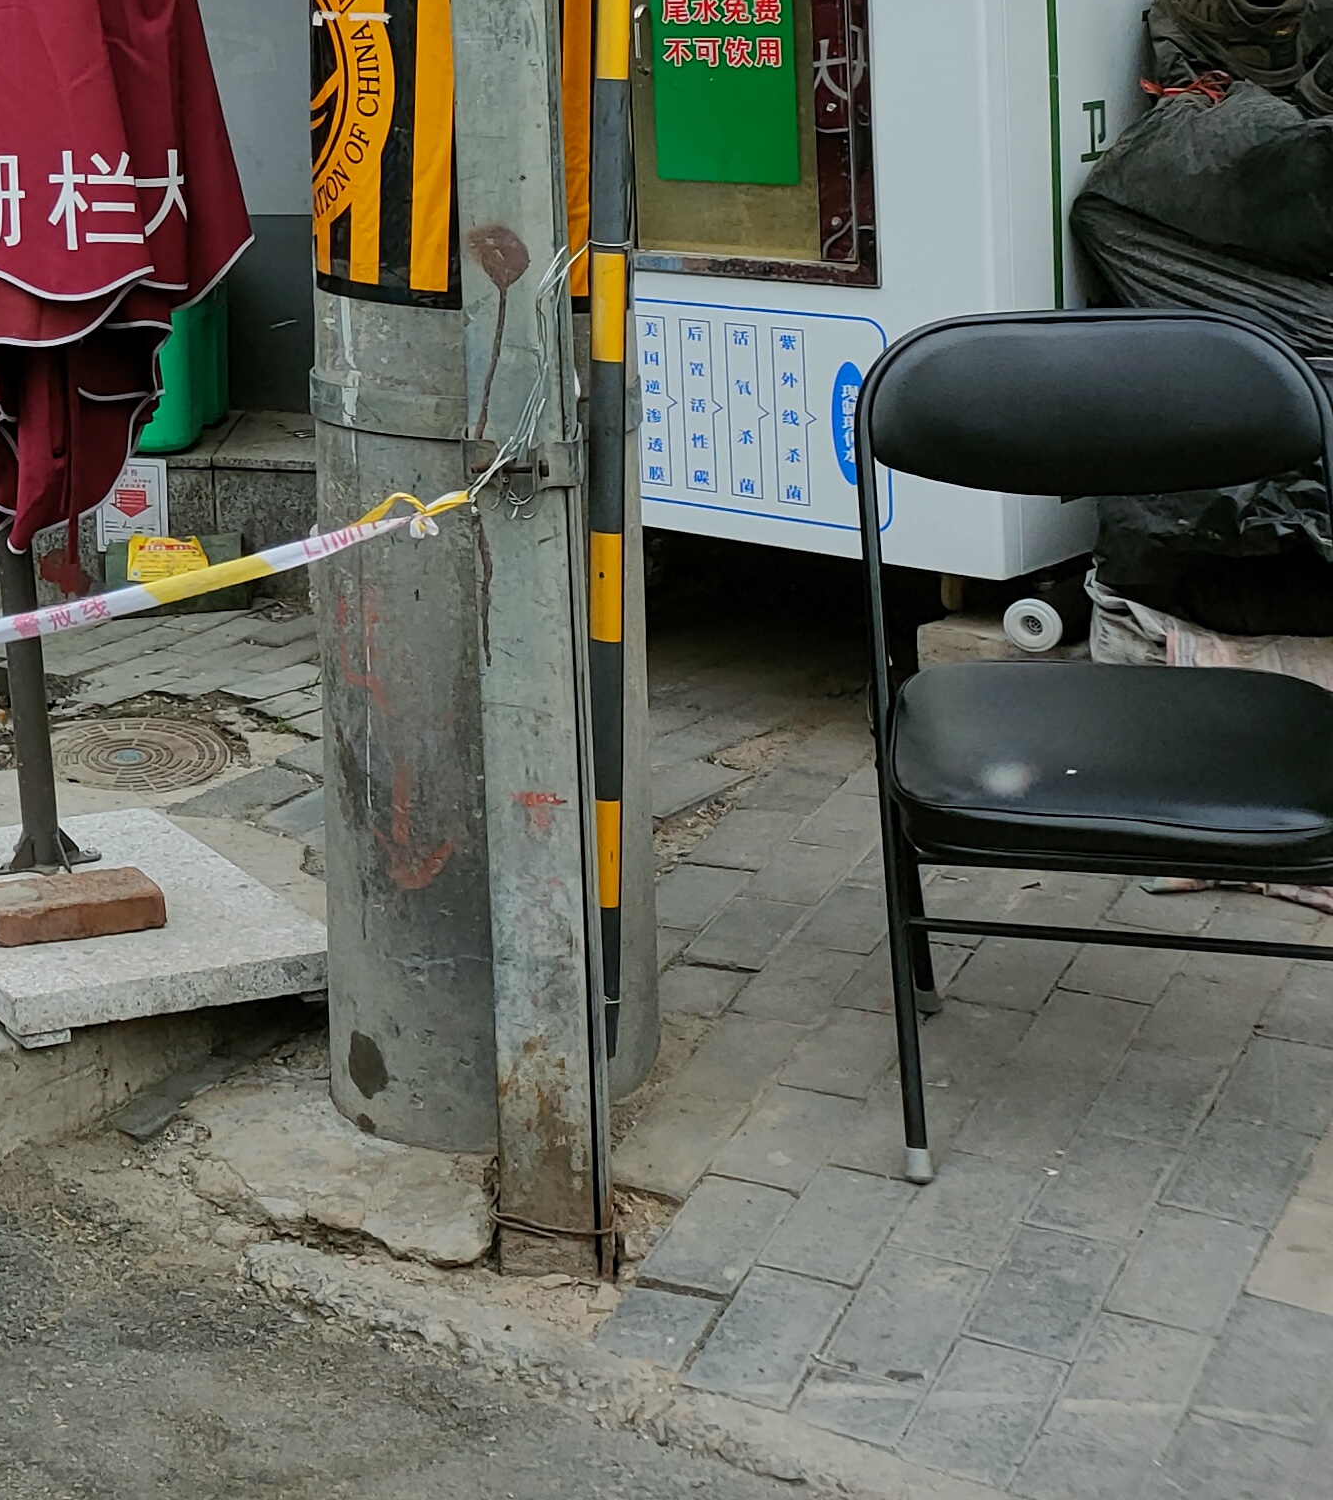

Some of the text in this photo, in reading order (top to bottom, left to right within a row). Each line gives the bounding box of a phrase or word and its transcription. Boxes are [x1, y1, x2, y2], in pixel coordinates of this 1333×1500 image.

[351, 21, 381, 118] CHINA
[662, 36, 782, 68] 不可饮用
[344, 122, 370, 165] OF
[644, 321, 666, 482] 美国逆渗透膜
[687, 326, 710, 486] 后置活性碳
[733, 330, 757, 495] 活氧杀菌
[779, 335, 803, 502] 紫外线杀菌
